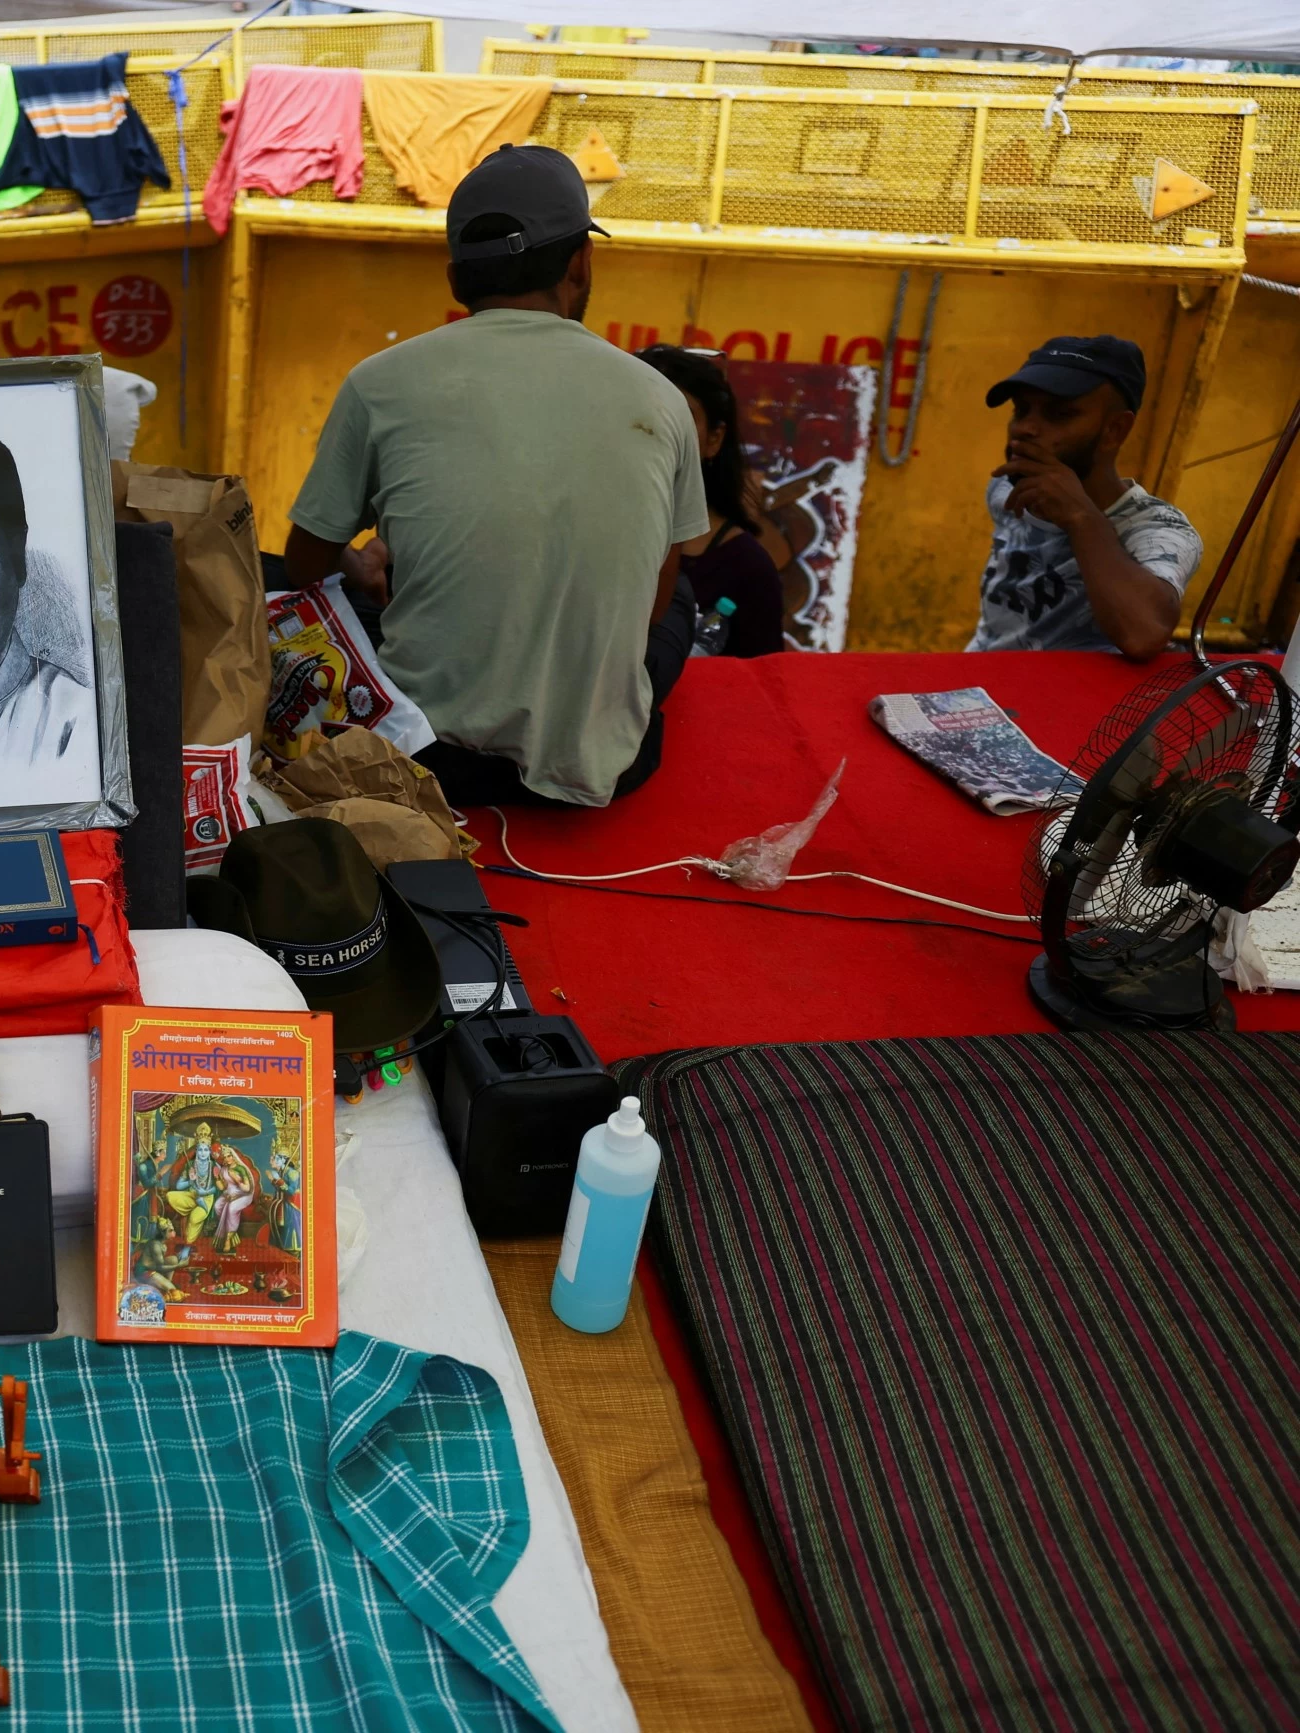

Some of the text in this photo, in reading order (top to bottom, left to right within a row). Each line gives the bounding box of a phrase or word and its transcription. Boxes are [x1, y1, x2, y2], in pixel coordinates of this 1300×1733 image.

[294, 926, 382, 967] SEA HORSE
[131, 1044, 303, 1076] श्रीरामचरितमानस
